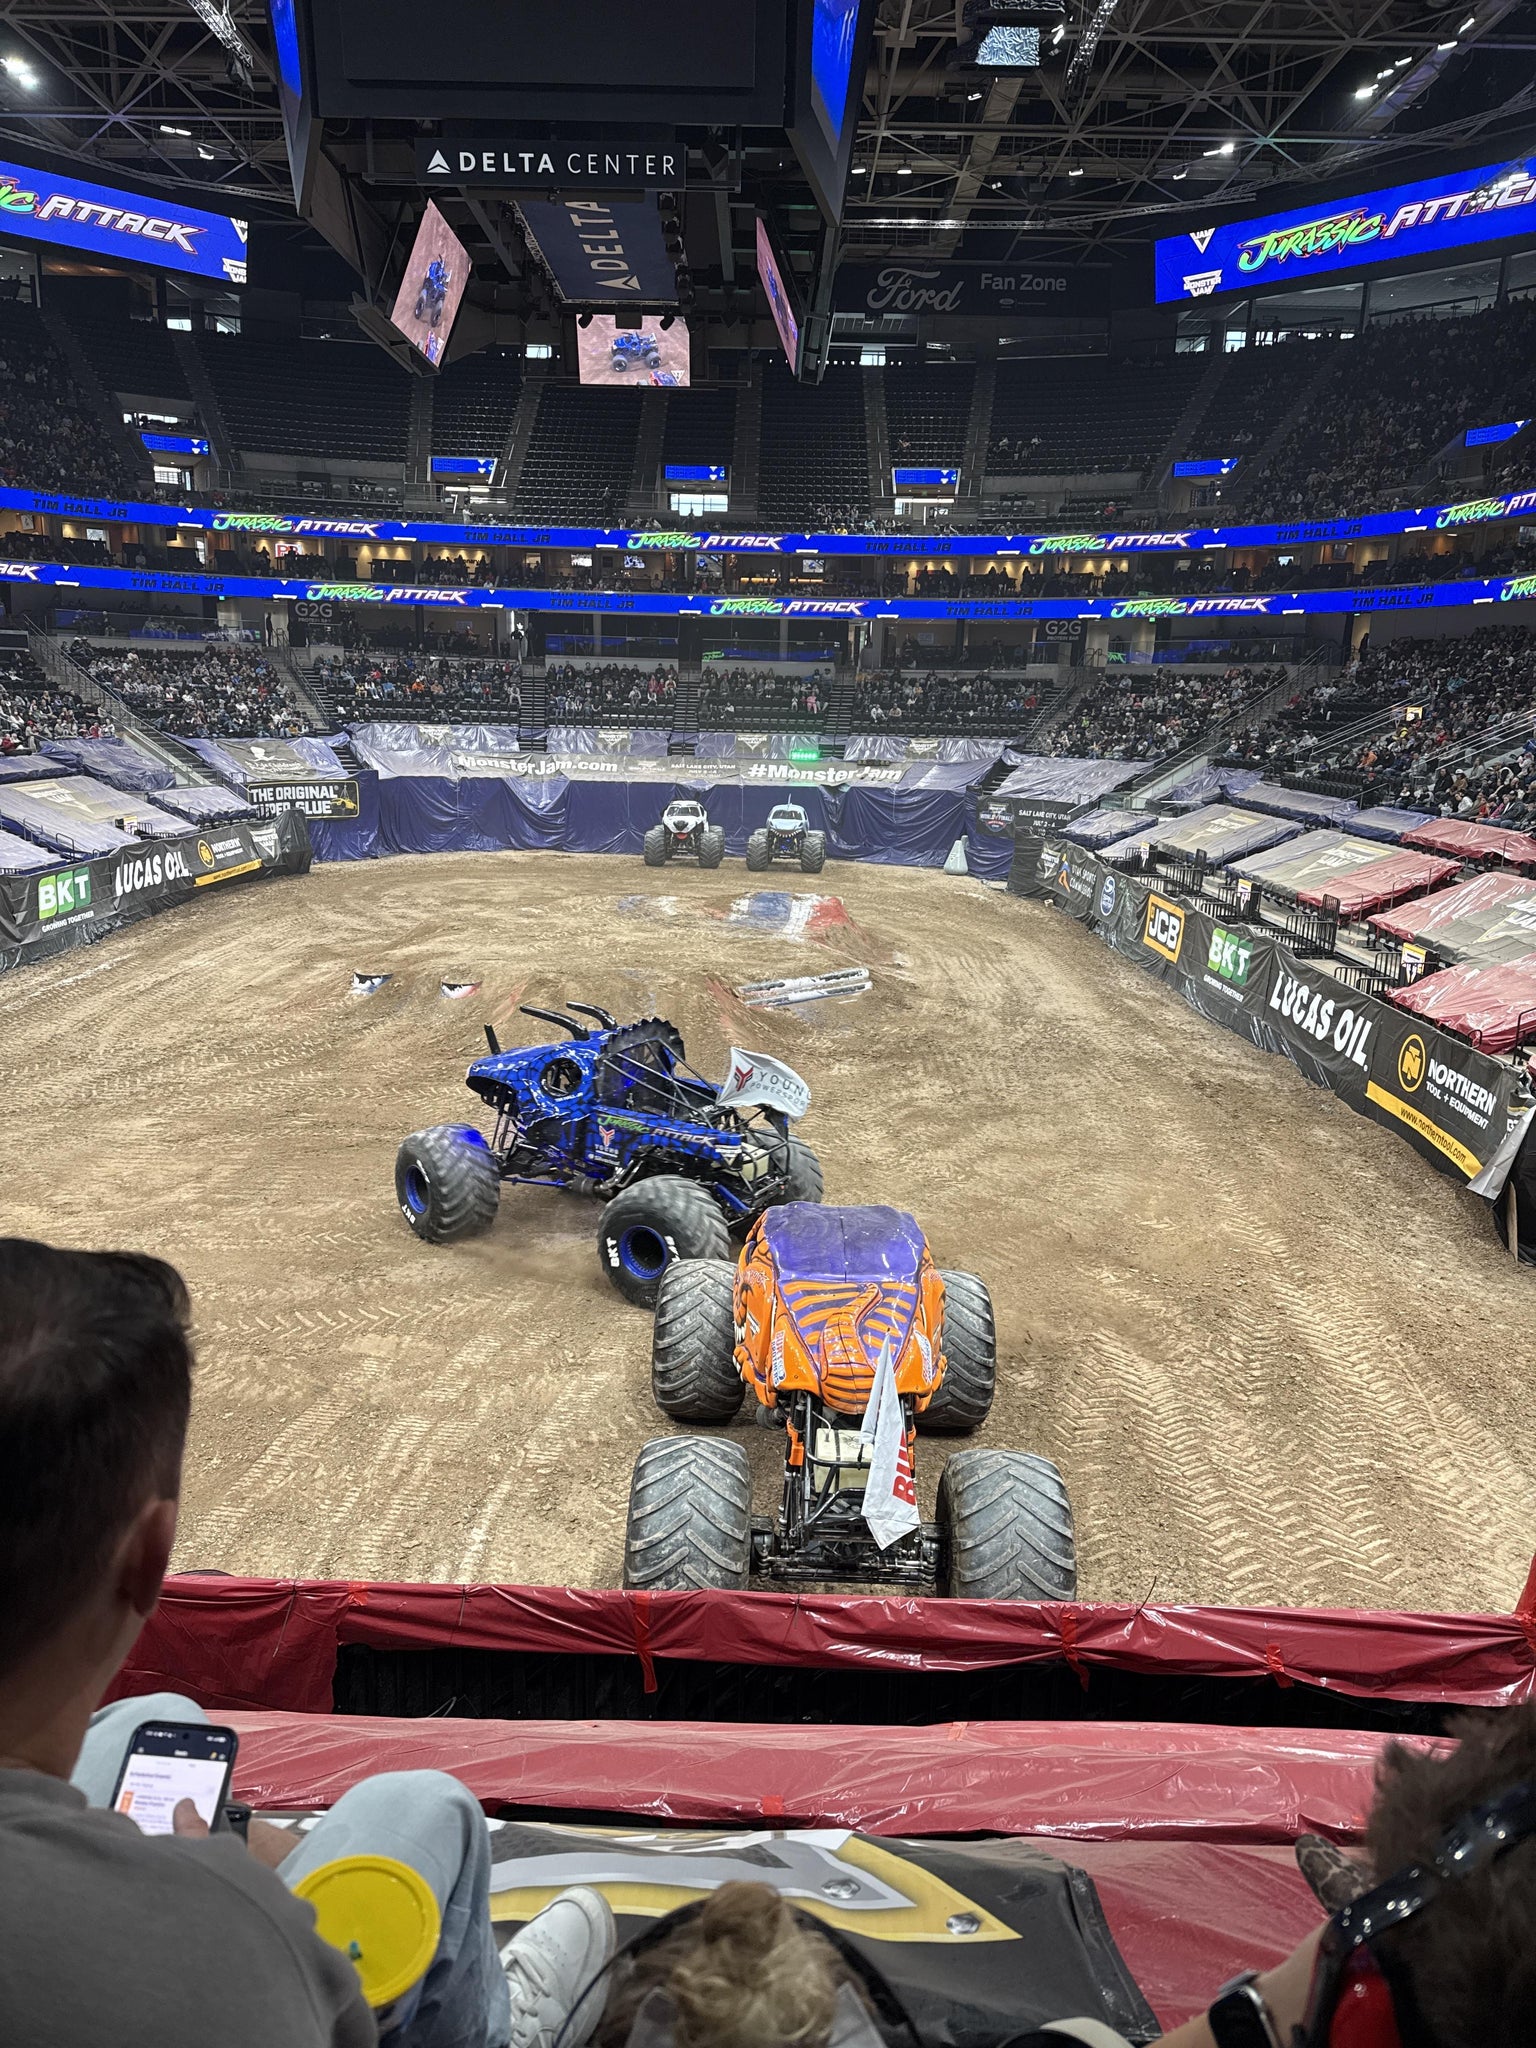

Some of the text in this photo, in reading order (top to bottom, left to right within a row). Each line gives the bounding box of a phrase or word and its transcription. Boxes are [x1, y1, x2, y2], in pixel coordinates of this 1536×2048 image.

[459, 151, 675, 176] DELTA CENTER
[39, 195, 201, 253] ATTACK
[564, 201, 630, 272] DELTA
[1237, 208, 1384, 272] JURASSIC
[866, 267, 965, 312] Ford
[980, 273, 1068, 292] Fan Zone
[1183, 277, 1222, 291] MONSTER
[32, 498, 129, 518] TIM HALL JR
[1435, 498, 1506, 528] JURASSIC
[213, 514, 382, 538] JURASSIC ATTACK
[1275, 524, 1363, 541] TIM HALL JR
[464, 531, 551, 543] TIM HALL JR
[627, 532, 785, 551] JURASSIC ATTACK
[865, 542, 952, 552] TIM HALL JR
[1030, 532, 1191, 554] JURASSIC ATTACK
[131, 577, 225, 593] TIM HALL JR
[306, 584, 472, 604] JURASSIC ATTACK
[295, 602, 333, 618] G2G
[550, 598, 635, 609] TIM HALL JR
[711, 598, 868, 616] JURASSIC ATTACK
[1110, 597, 1274, 618] JURASSIC ATTACK
[1351, 593, 1435, 608] TIM HALL JR
[945, 606, 1034, 616] TIM HALL JR
[1045, 620, 1082, 636] G2G
[457, 756, 618, 775] MonsterJam.com
[747, 763, 903, 783] #MonsterJam
[250, 787, 274, 803] THE
[295, 800, 333, 815] GLUE
[1057, 812, 1071, 820] UTAH
[115, 854, 162, 897] LUCAS
[39, 873, 90, 912] BKT
[41, 910, 95, 933] GROWING TOGETHER
[1148, 907, 1180, 950] JCB
[1208, 934, 1252, 977] BKT
[1221, 983, 1245, 1003] TOGETHER
[1269, 970, 1336, 1041] LUCAS
[1427, 1058, 1497, 1117] NORTHERN
[1425, 1080, 1442, 1099] TOOL
[1448, 1096, 1490, 1131] EQUIPMENT
[651, 1128, 718, 1148] ATTACK
[1400, 1107, 1467, 1165] www.northerntool.com
[402, 1204, 417, 1224] BKT
[606, 1236, 620, 1268] BKT
